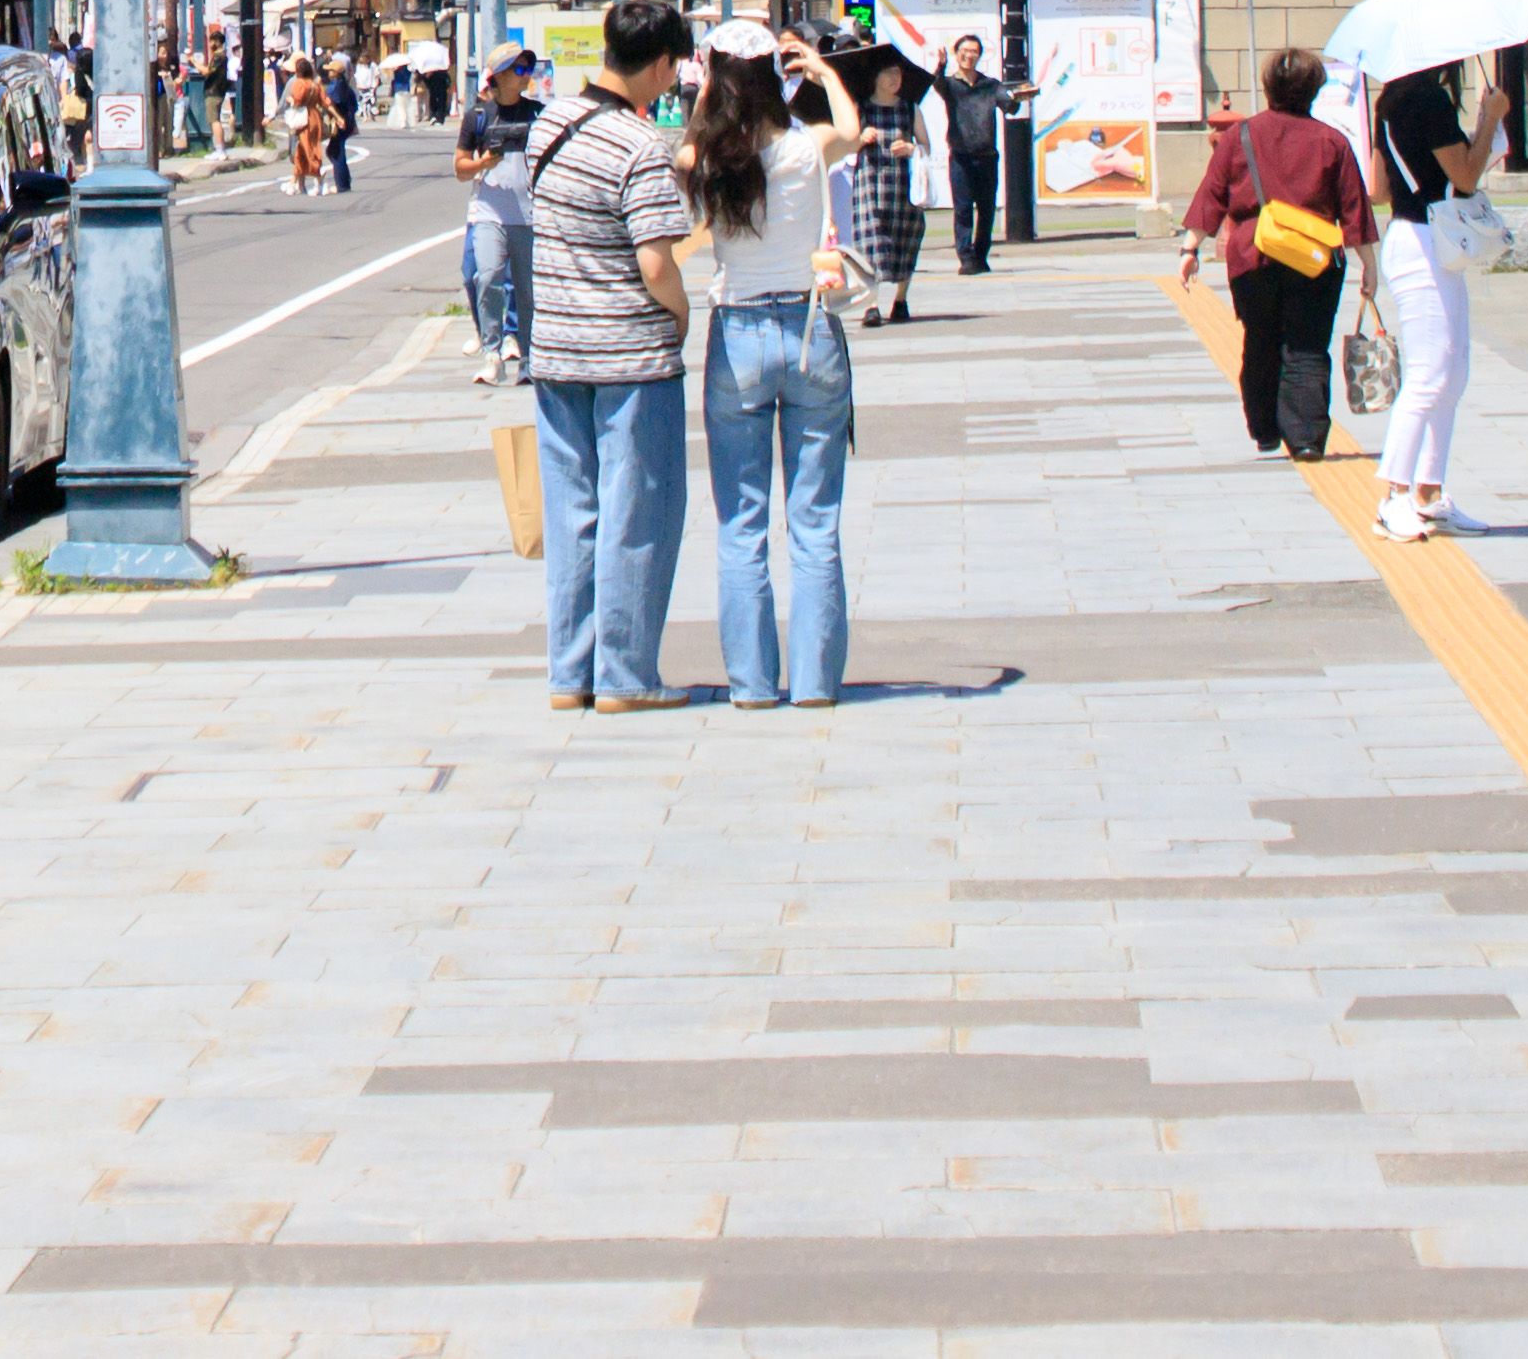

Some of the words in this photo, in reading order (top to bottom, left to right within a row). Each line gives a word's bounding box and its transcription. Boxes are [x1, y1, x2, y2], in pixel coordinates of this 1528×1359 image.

[1100, 101, 1145, 110] ガラスペン
